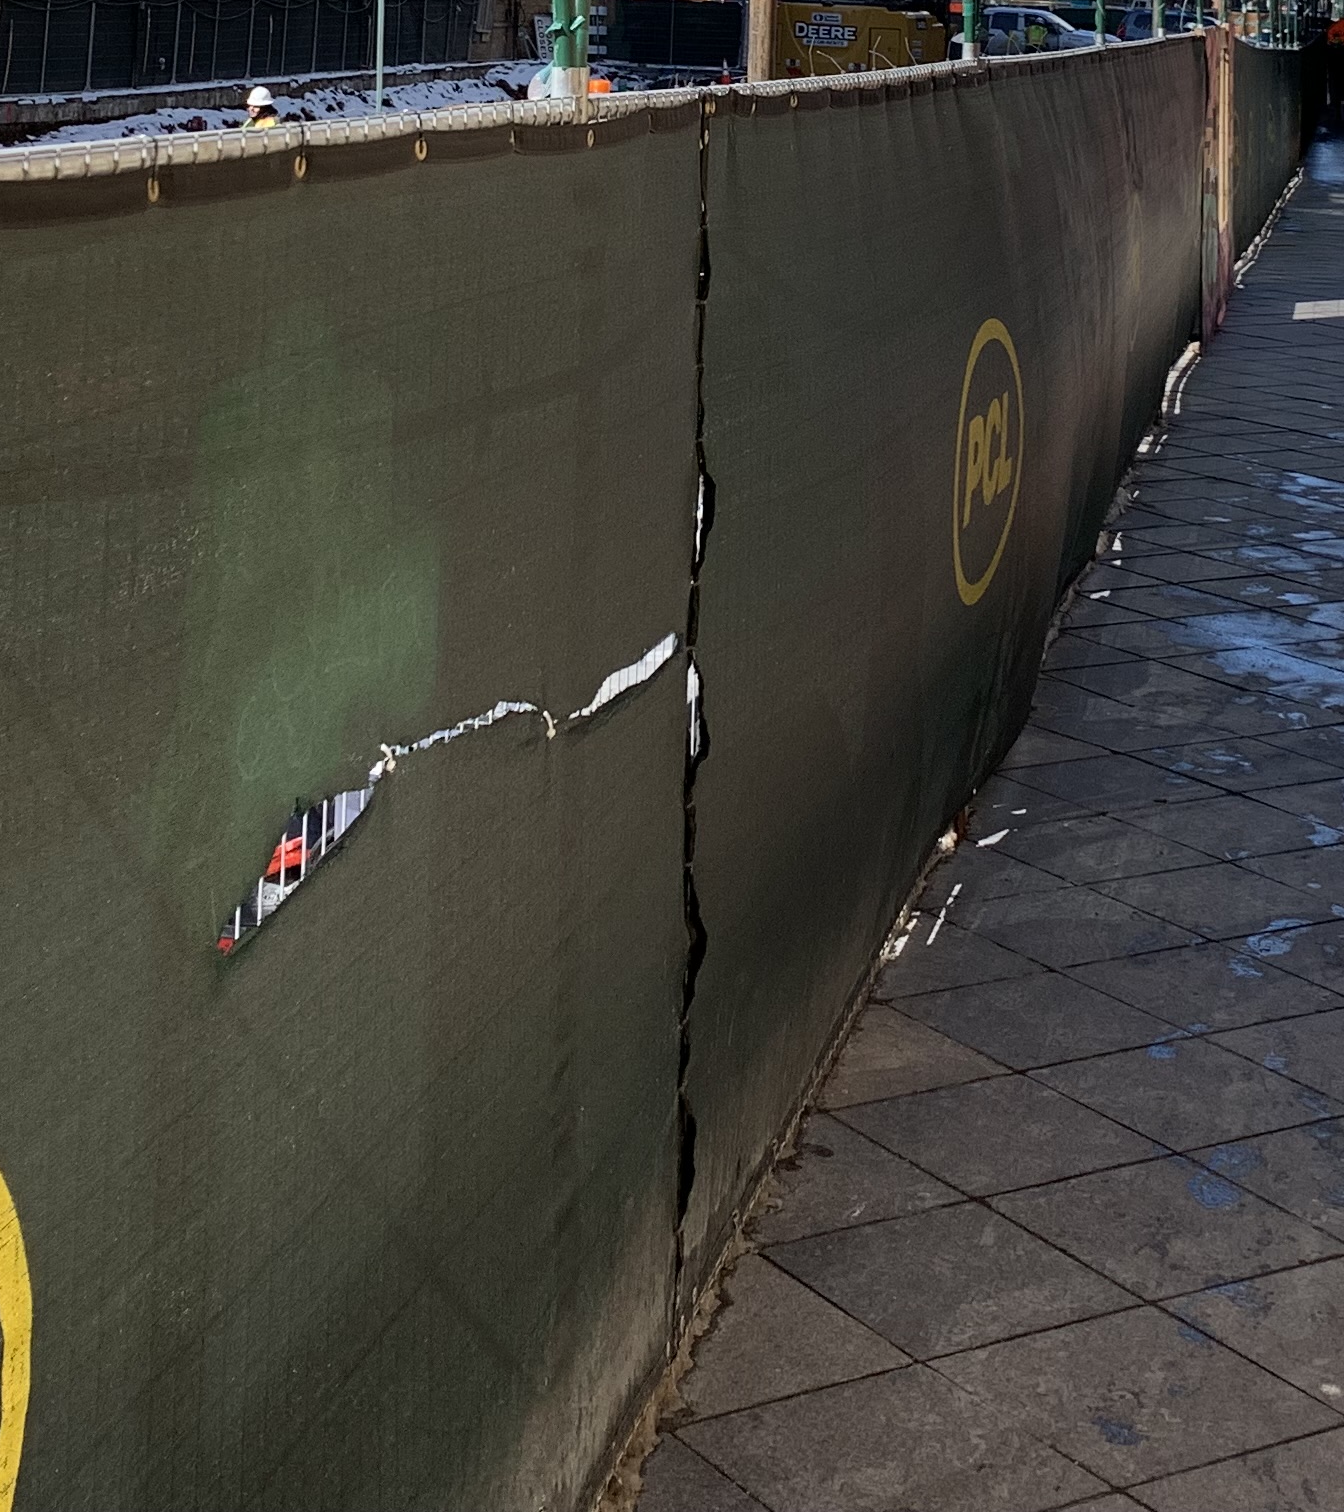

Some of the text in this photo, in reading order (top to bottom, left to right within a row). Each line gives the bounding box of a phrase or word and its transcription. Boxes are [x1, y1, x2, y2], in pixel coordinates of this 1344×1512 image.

[537, 19, 547, 58] CLOSED
[795, 23, 856, 40] DEERE
[963, 391, 1013, 530] PCL
